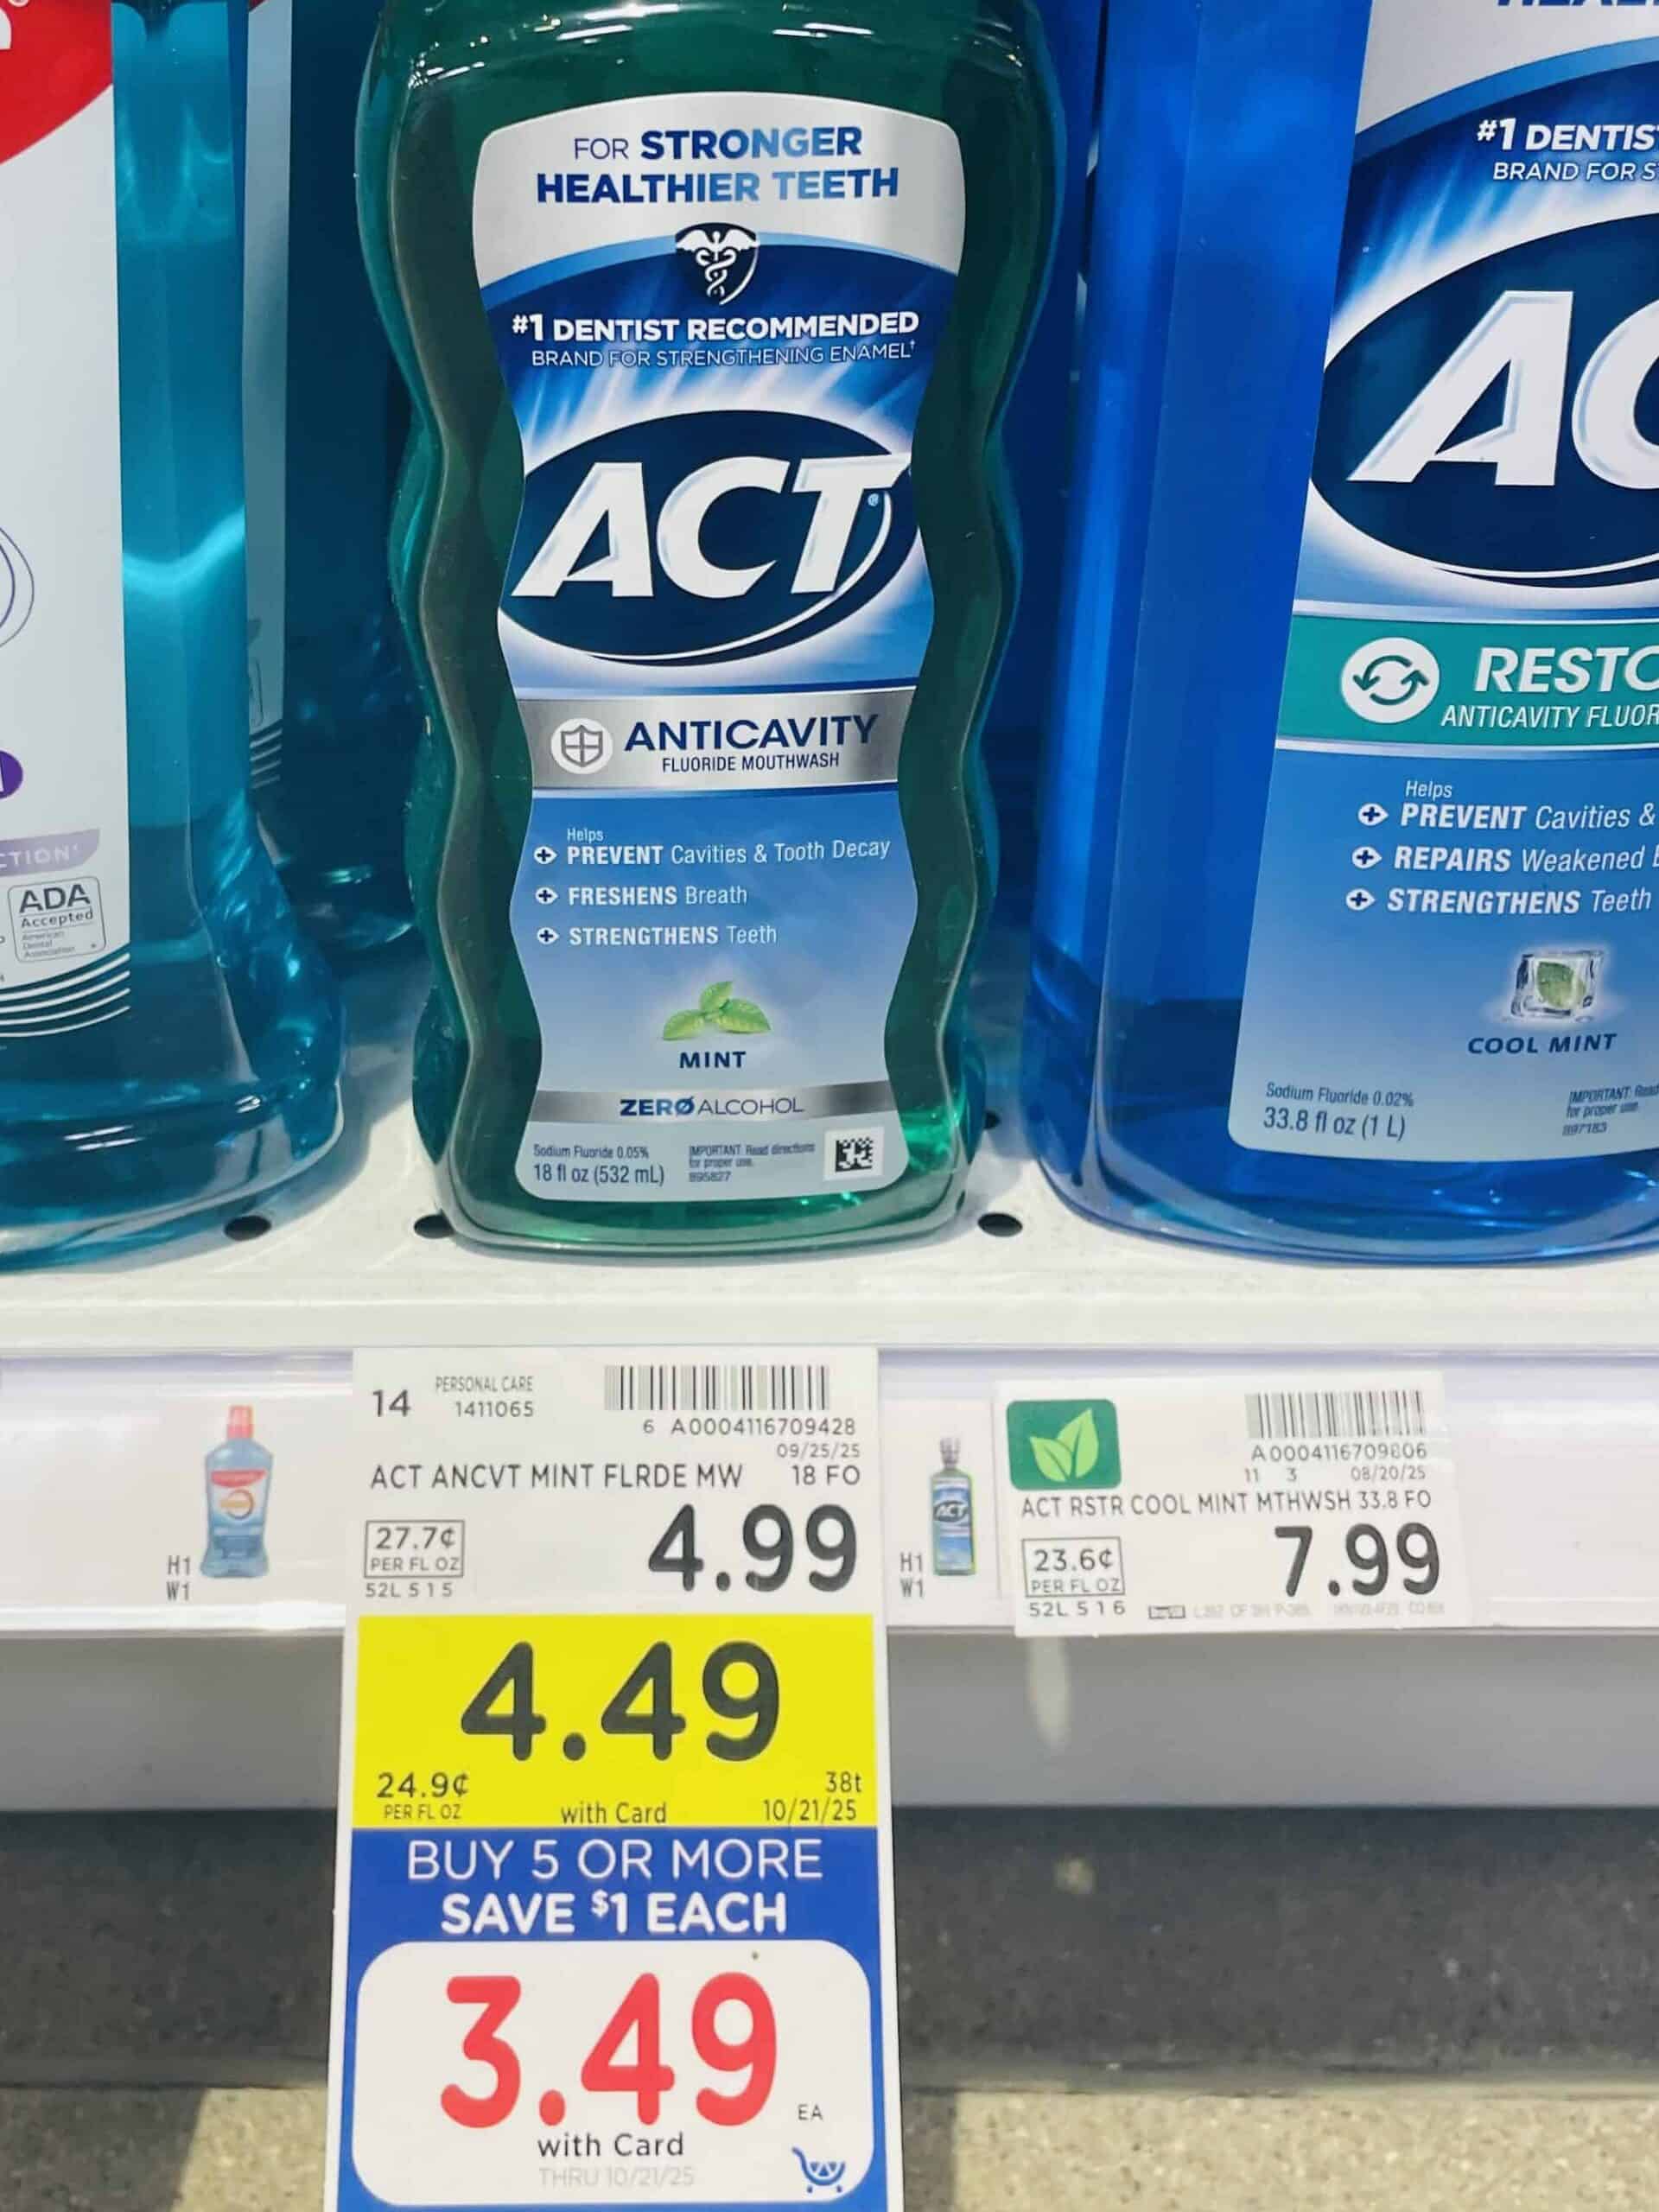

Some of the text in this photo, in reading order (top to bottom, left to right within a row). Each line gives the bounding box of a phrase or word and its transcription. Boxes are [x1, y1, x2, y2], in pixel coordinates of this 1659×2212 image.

[575, 126, 862, 160] FOR STRONGER
[1477, 118, 1659, 150] #1 DENTIS
[1493, 162, 1580, 181] BRAND
[1586, 162, 1636, 181] FOR
[537, 168, 899, 204] HEALTHIER TEETH
[512, 311, 919, 341] #1 DENTIST RECOMMENDED
[532, 349, 603, 366] BRAND
[609, 349, 651, 366] FOR
[656, 346, 823, 366] STRENGTHENING
[511, 453, 912, 599] ACT
[1441, 705, 1580, 728] ANTICAVITY
[625, 714, 879, 752] ANTICAVITY
[663, 753, 840, 772] FLUORIDE MOUTHWASH
[1405, 780, 1452, 800] Helps
[1401, 803, 1655, 830] PREVENT Cavities &
[567, 829, 603, 843] Helps
[567, 839, 891, 865] PREVENT Cavities & Tooth Decay
[1394, 846, 1511, 872] REPAIRS
[1521, 846, 1644, 873] Weakened
[19, 884, 91, 913] ADA
[569, 886, 747, 906] FRESHENS Breath
[1387, 887, 1651, 914] STRENGTHENS Teeth
[22, 906, 92, 928] Accepted
[569, 925, 777, 945] STRENGTHENS Teeth
[1468, 1033, 1618, 1054] COOL MINT
[679, 1051, 747, 1069] MINT
[1266, 1082, 1414, 1107] Sodium Fluoride 0.02%
[698, 1097, 804, 1115] ALCOHOL
[1263, 1107, 1405, 1141] 33.8 fl oz (1 L)
[533, 1144, 649, 1159] Sodium Fluoride 0.05%
[535, 1164, 664, 1186] 18 fl oz (532 mL)
[435, 1376, 533, 1392] PERSONAL CARE
[372, 1389, 410, 1418] 14
[455, 1401, 534, 1418] 1411065
[643, 1418, 855, 1435] 6 A0004116709428
[777, 1443, 861, 1459] 09/25/25
[371, 1464, 861, 1489] ACT ANCVT MINT FLRDE MW 18 FO
[1287, 1467, 1297, 1482] 3
[1351, 1465, 1426, 1481] 08/20/25
[1021, 1489, 1431, 1517] ACT RSTR COOL MINT MTHWSH 33.8 FO
[376, 1527, 455, 1548] 27.7¢
[648, 1503, 857, 1593] 4.99
[168, 1555, 190, 1575] H1
[371, 1557, 459, 1571] PER FL OZ
[899, 1552, 923, 1573] H1
[1034, 1548, 1112, 1571] 23.6¢
[1274, 1522, 1440, 1599] 7.99
[167, 1581, 190, 1600] W1
[365, 1582, 401, 1598] 52L
[899, 1579, 924, 1598] W1
[1031, 1578, 1120, 1592] PER FL OZ
[1029, 1601, 1067, 1617] 52L
[461, 1641, 779, 1762] 4.49
[377, 1772, 469, 1799] 24.9¢
[825, 1771, 862, 1793] 38t
[384, 1805, 461, 1820] PER FL OZ
[561, 1802, 667, 1824] with Card
[763, 1799, 857, 1821] 10/21/25
[408, 1839, 823, 1880] BUY 5 OR MORE
[442, 1890, 787, 1935] SAVE $1 EACH
[441, 1972, 778, 2128] 3.49
[798, 2104, 823, 2120] EA
[537, 2132, 683, 2158] with Card
[539, 2165, 696, 2186] THRU 10/21/25
